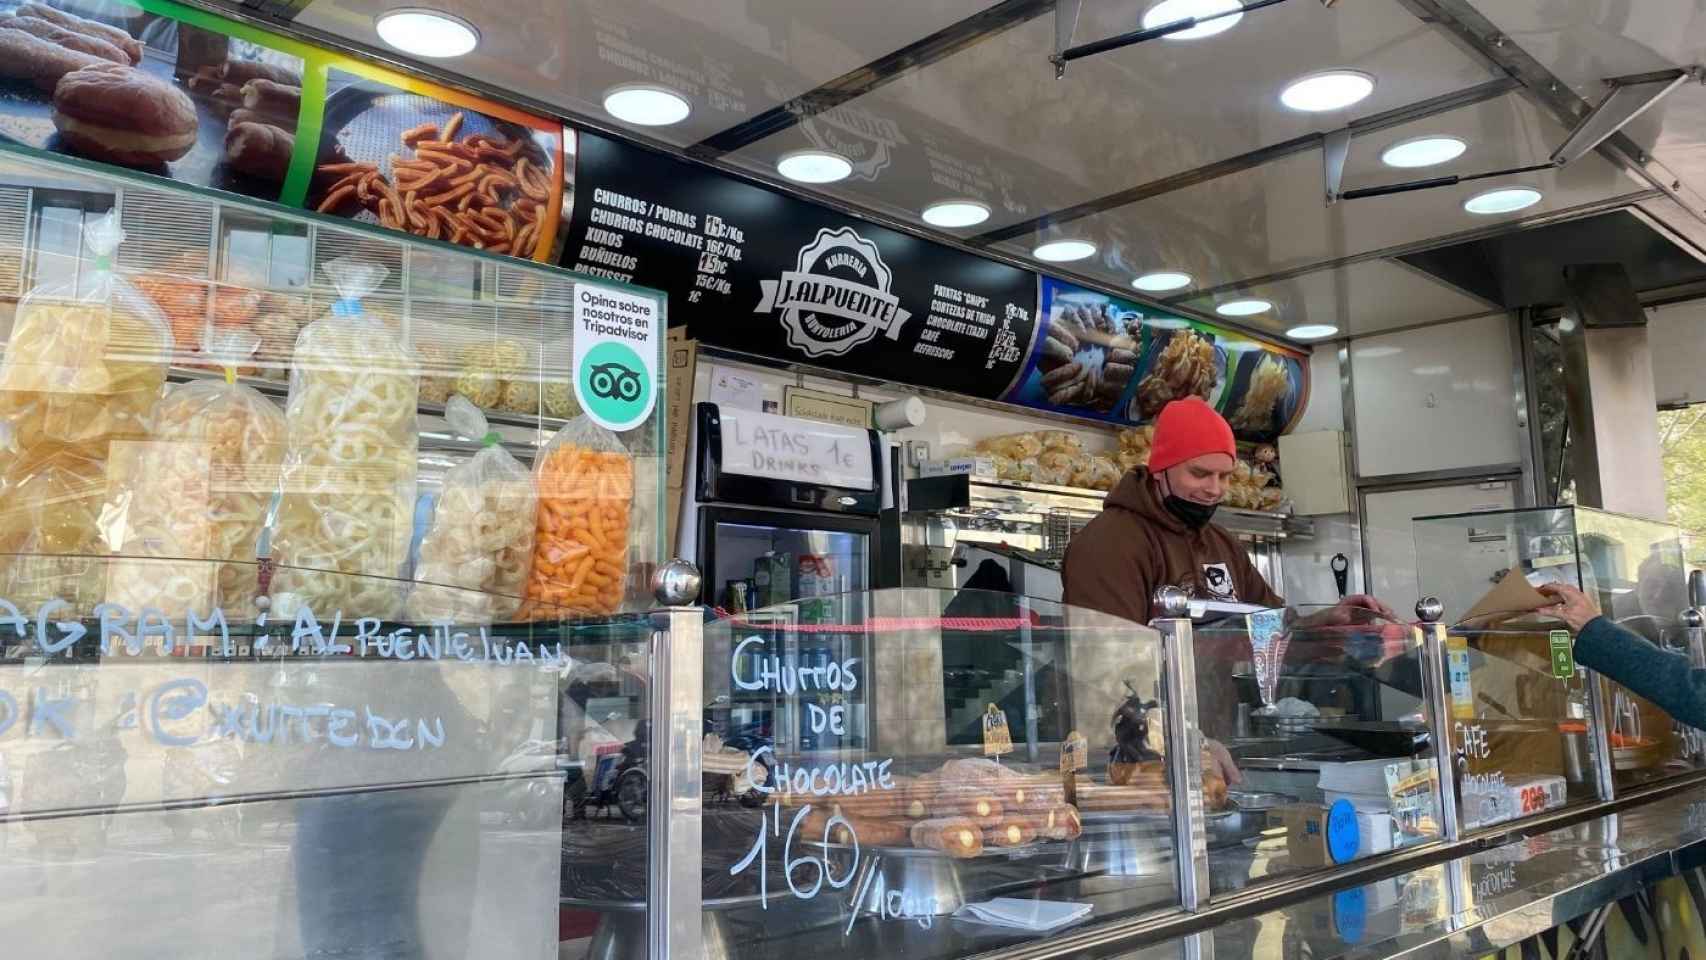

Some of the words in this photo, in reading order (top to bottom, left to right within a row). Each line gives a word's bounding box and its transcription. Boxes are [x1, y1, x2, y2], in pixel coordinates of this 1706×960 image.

[594, 188, 646, 216] CHURROS
[656, 205, 697, 229] PORRAS
[585, 227, 623, 248] XUXOS
[591, 207, 643, 234] CHURROS
[645, 222, 704, 250] CHOCOLATE
[581, 291, 617, 309] Opina
[619, 300, 651, 316] sobre
[780, 279, 896, 323] J.ALPUENTE
[934, 284, 963, 302] PATATAS
[583, 307, 633, 325] nosotros
[635, 318, 649, 329] en
[931, 300, 966, 318] CORTEZAS
[584, 319, 649, 342] Tripadvisor
[927, 314, 966, 335] CHOCOLATE
[736, 420, 808, 455] LATAS
[752, 449, 819, 475] DRINKS
[809, 703, 845, 735] DE
[747, 745, 896, 795] CHOCOLATE
